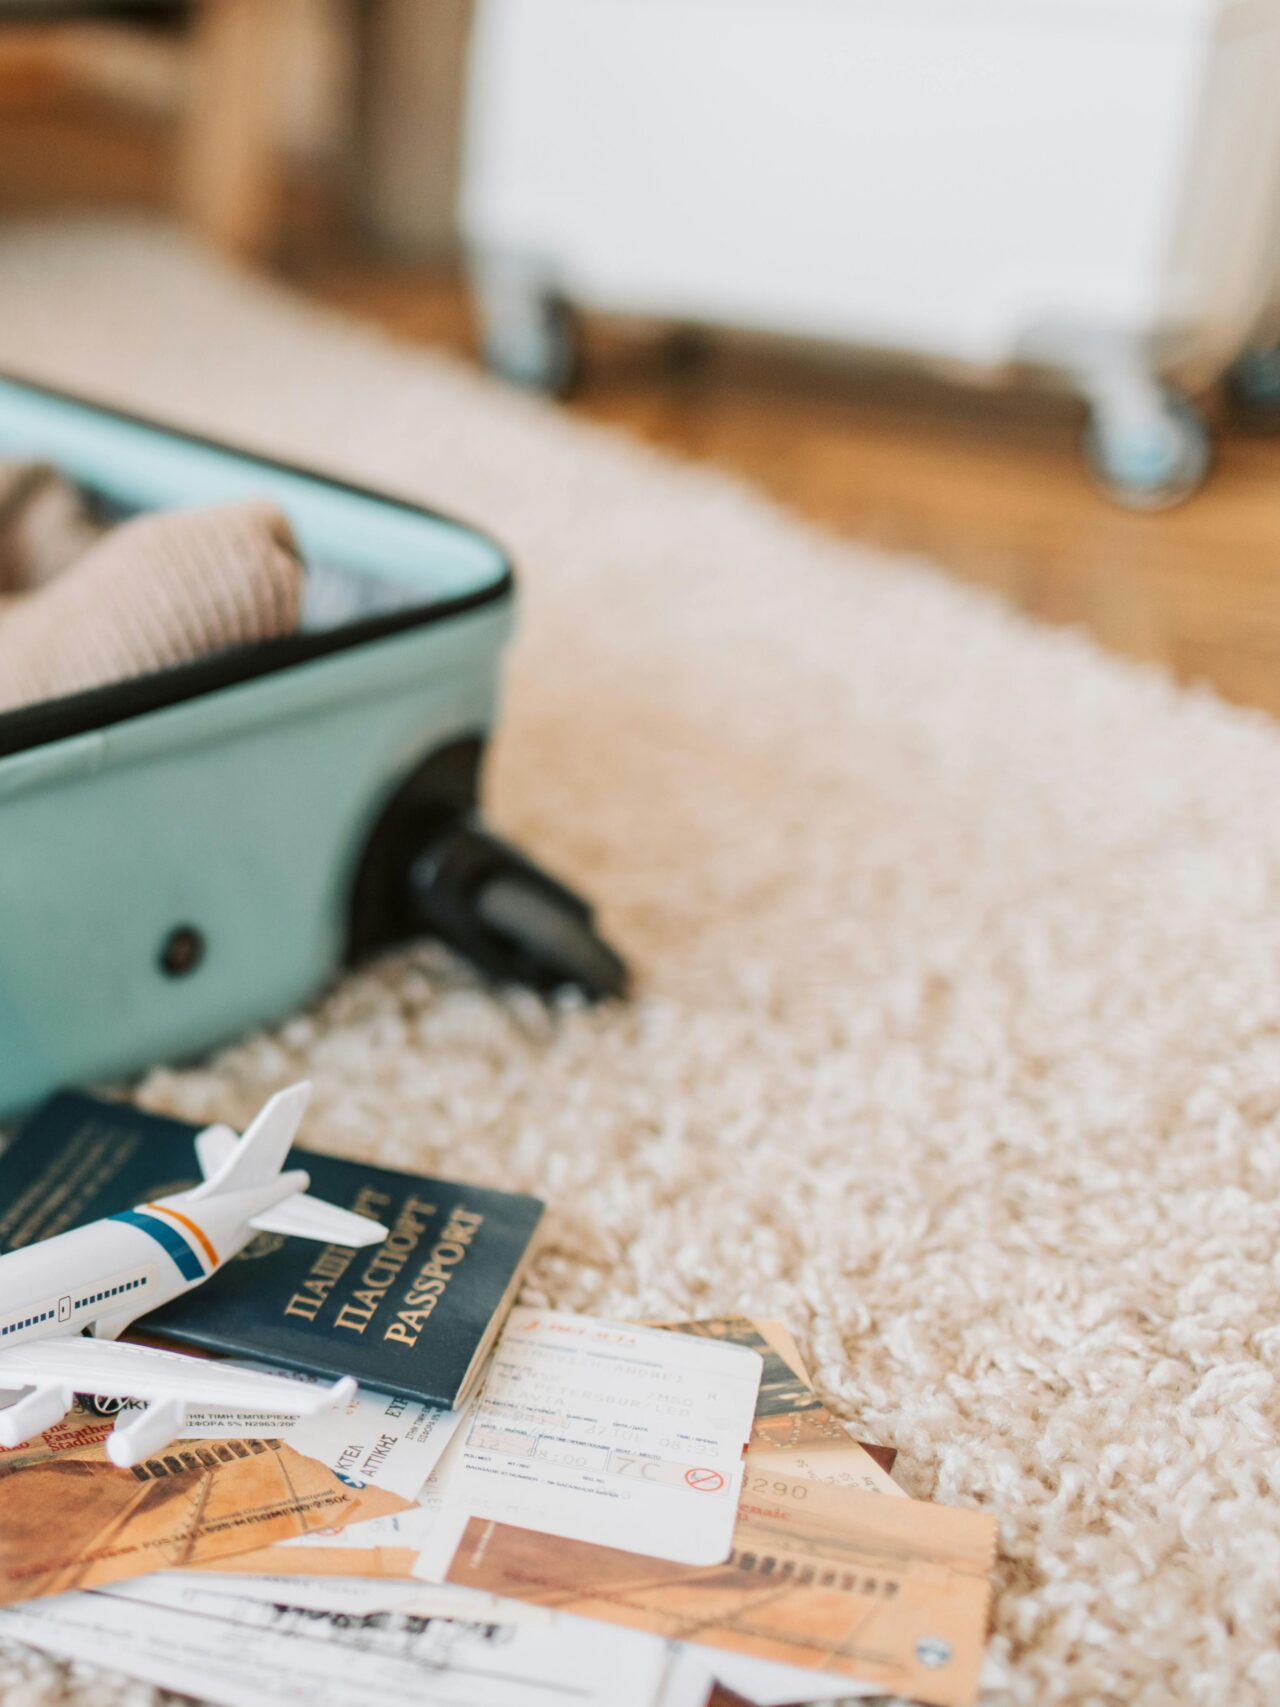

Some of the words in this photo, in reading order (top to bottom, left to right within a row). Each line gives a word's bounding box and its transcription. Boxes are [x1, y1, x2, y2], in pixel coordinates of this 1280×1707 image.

[333, 1195, 439, 1335] ПАСПОРТ
[383, 1204, 484, 1348] PASSPORT
[334, 1444, 365, 1471] ΚΤΕΛ
[360, 1433, 398, 1478] ΑΤΤΙΚΗΣ
